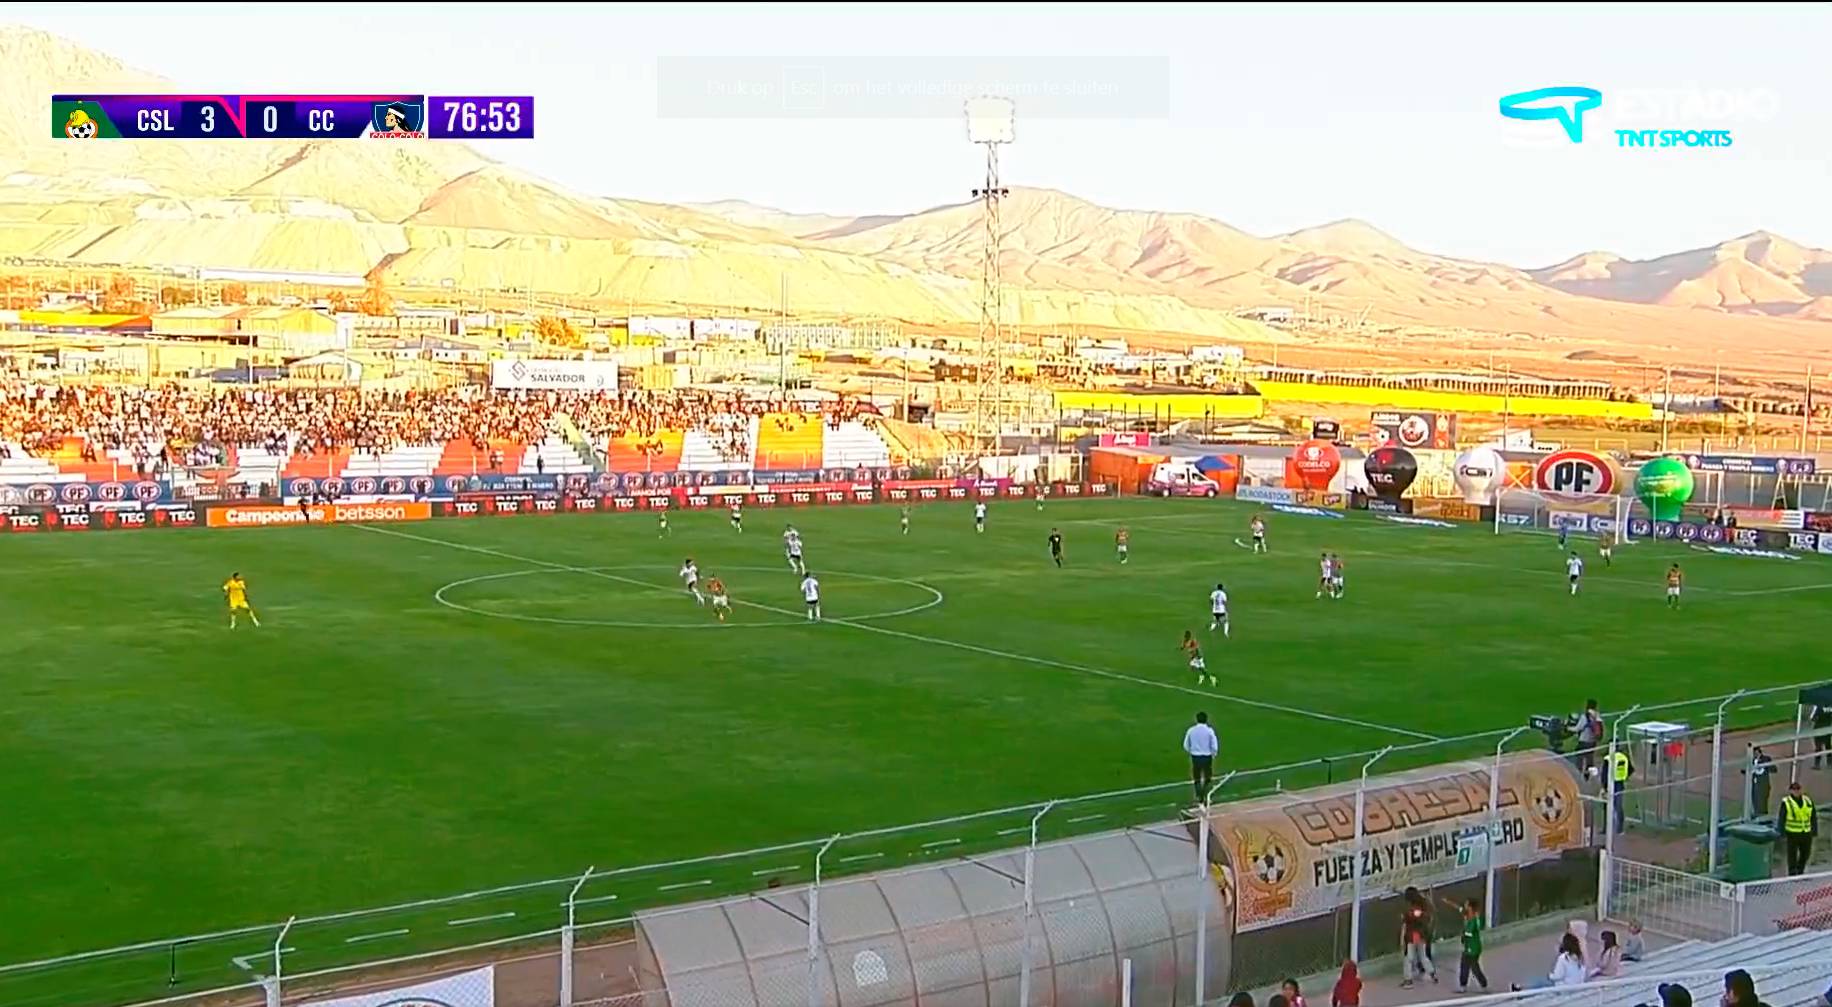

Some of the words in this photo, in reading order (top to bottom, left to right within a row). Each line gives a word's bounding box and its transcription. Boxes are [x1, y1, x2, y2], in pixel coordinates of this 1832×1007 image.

[531, 374, 585, 383] SALVADOR
[1370, 473, 1394, 483] TEC
[1554, 461, 1594, 492] PF
[358, 481, 370, 490] PF
[1065, 485, 1080, 493] TEC
[1092, 484, 1107, 492] TEC
[70, 487, 84, 498] PF
[105, 486, 120, 498] PF
[140, 486, 155, 498] PF
[856, 491, 873, 500] TEC
[890, 490, 907, 499] TEC
[921, 489, 937, 497] TEC
[950, 489, 966, 497] TEC
[979, 487, 996, 496] TEC
[1009, 487, 1024, 495] TEC
[689, 496, 708, 505] TEC
[758, 494, 776, 503] TEC
[792, 493, 810, 502] TEC
[826, 492, 843, 501] TEC
[535, 501, 556, 510] TEC
[575, 500, 595, 509] TEC
[614, 498, 634, 507] TEC
[649, 497, 669, 506] TEC
[455, 503, 478, 512] TEC
[496, 502, 518, 511] TEC
[168, 511, 196, 522] TEC
[335, 505, 405, 520] betsson
[9, 515, 39, 526] TEC
[61, 514, 90, 525] TEC
[119, 513, 146, 523] TEC
[1788, 533, 1815, 544] TEC
[1385, 844, 1395, 869] Y
[1399, 830, 1460, 868] TEMPLE
